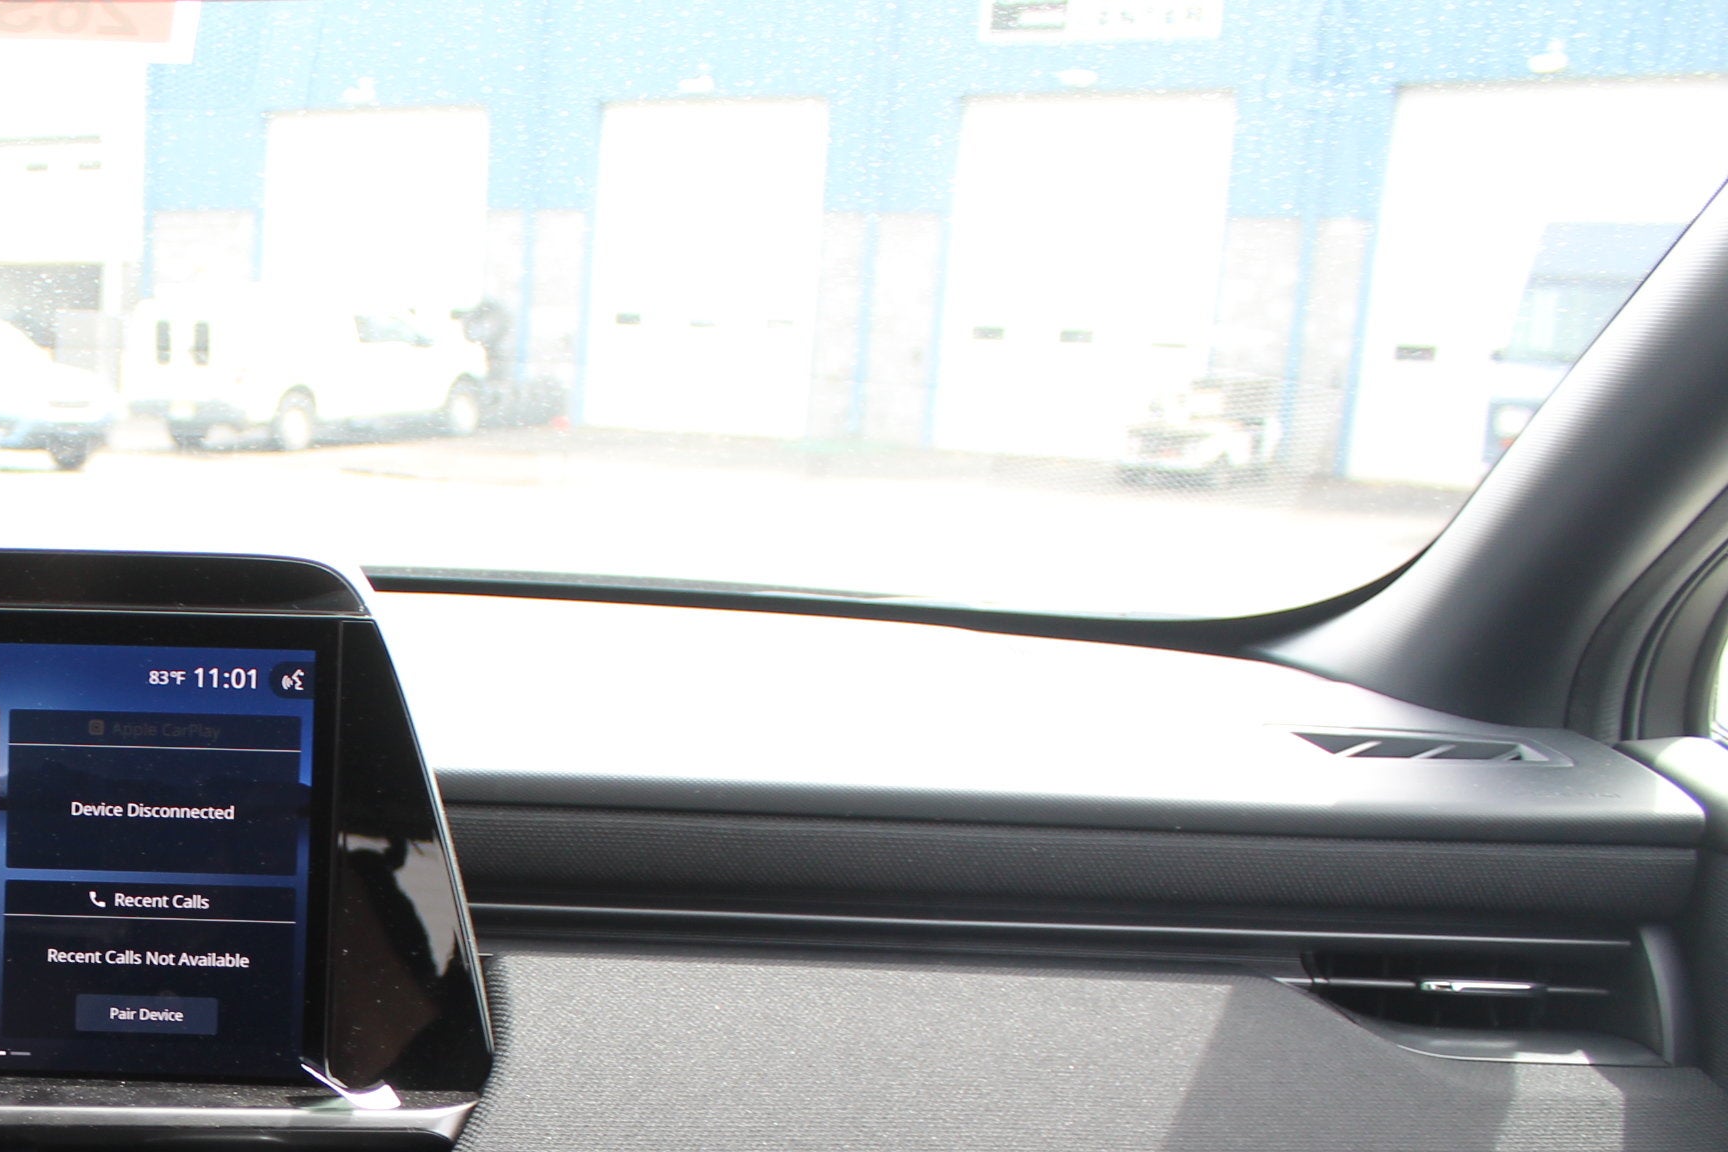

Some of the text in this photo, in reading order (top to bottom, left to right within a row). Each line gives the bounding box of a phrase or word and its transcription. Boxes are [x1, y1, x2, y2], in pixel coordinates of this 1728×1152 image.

[149, 667, 258, 689] 83°F 11:01
[112, 723, 220, 741] Apple CarPlay
[71, 801, 235, 820] Device Disconnected
[114, 893, 210, 909] Recent Calls
[47, 949, 250, 968] Recent Calls Not Available
[109, 1007, 184, 1021] Pair Device
